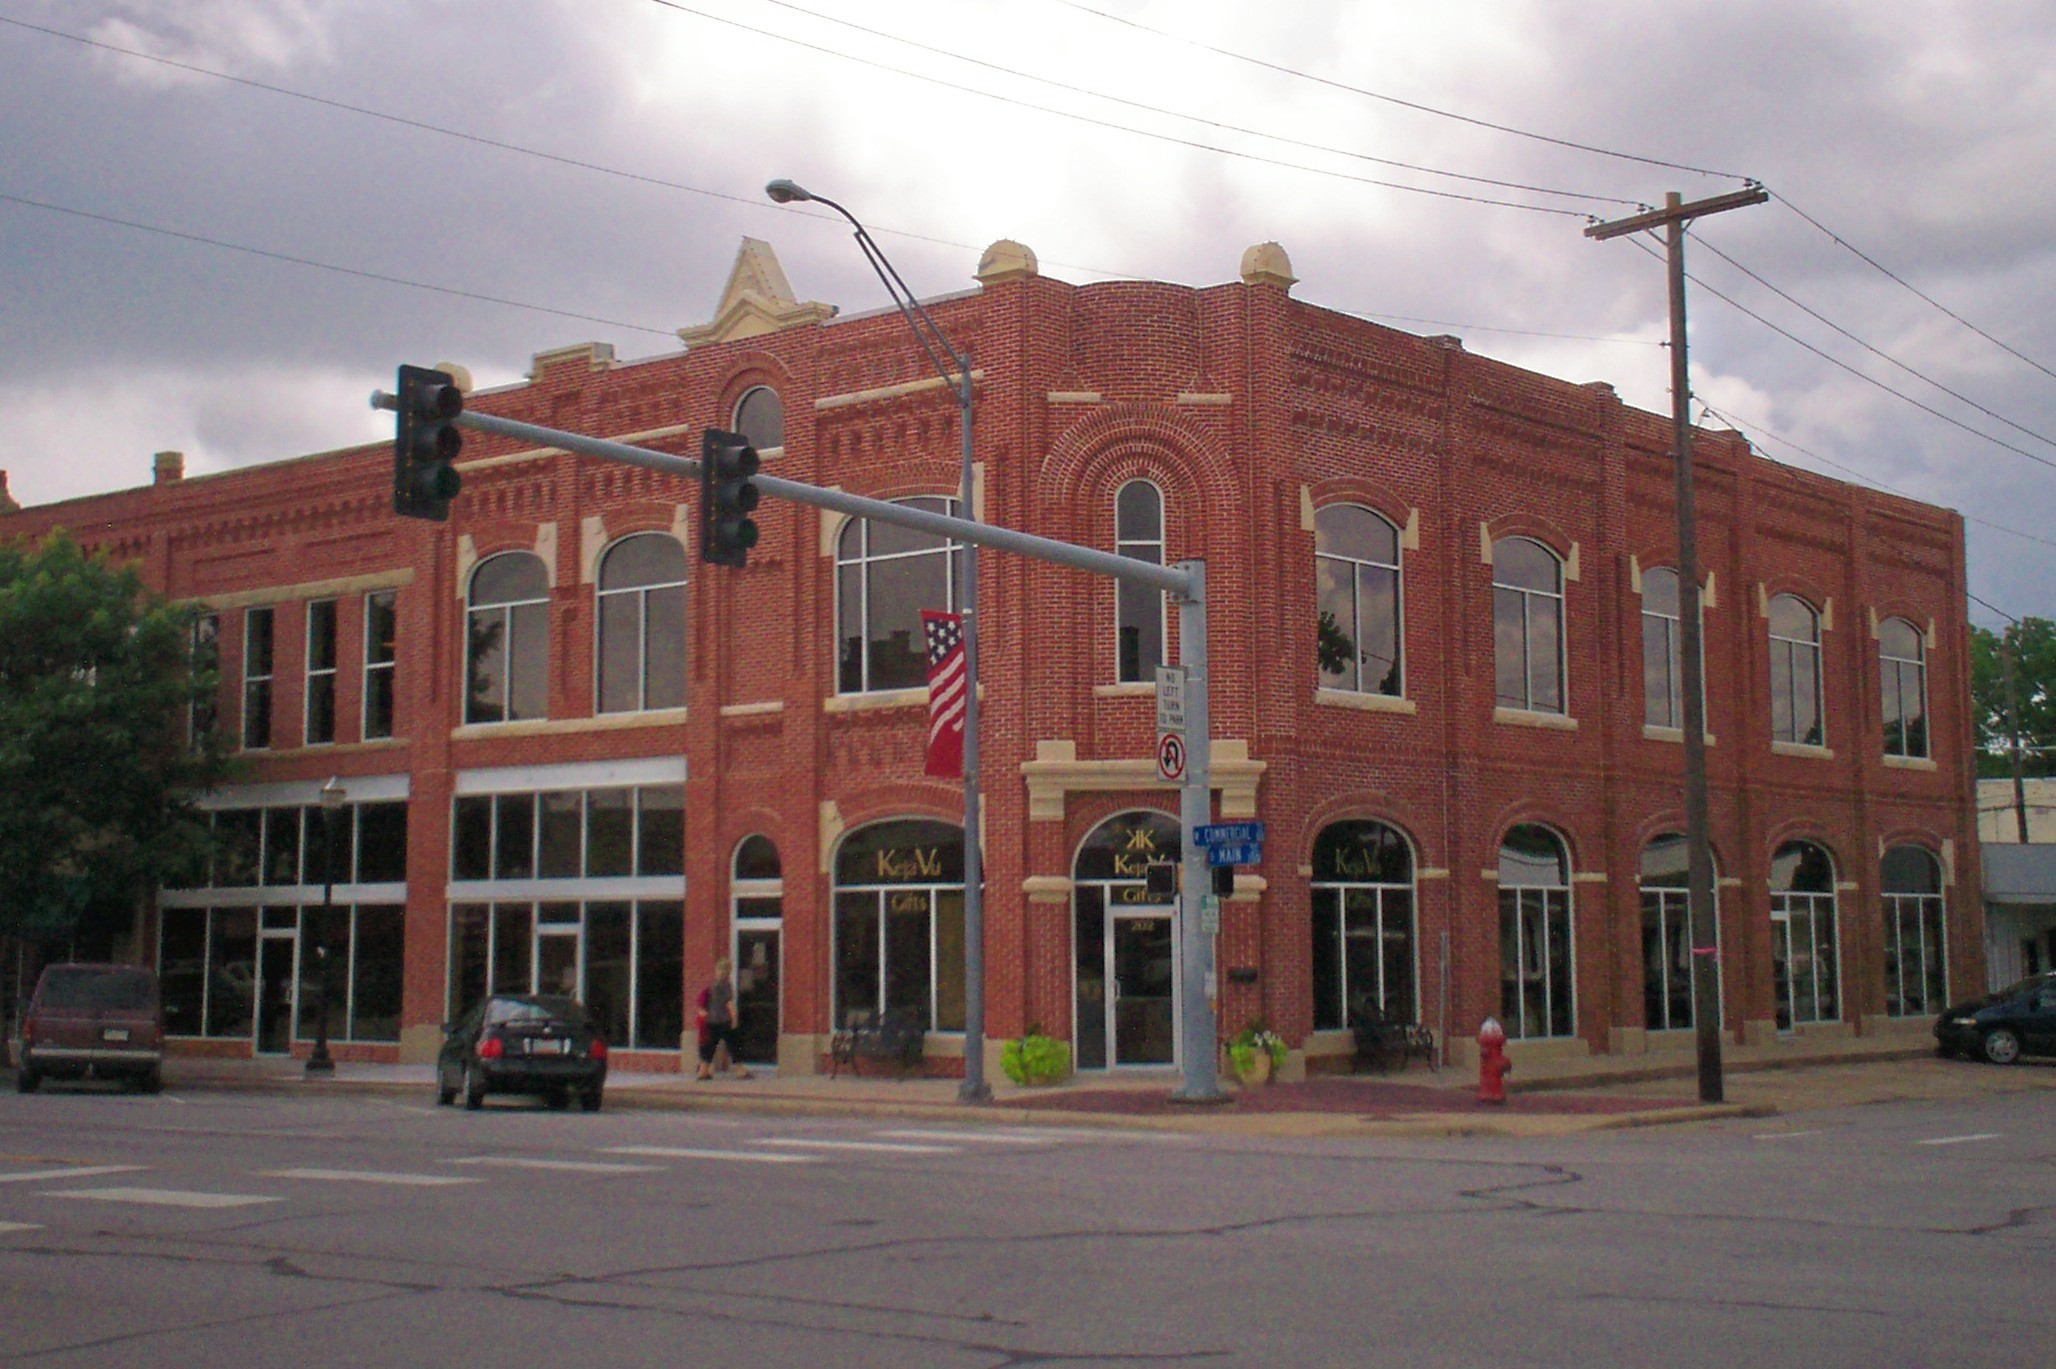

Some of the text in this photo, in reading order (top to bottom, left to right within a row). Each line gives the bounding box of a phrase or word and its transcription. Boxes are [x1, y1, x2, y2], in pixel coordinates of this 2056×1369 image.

[1166, 672, 1176, 684] NO
[1162, 685, 1179, 697] LEFT
[1163, 698, 1180, 711] TURN
[1204, 825, 1251, 843] COMMERCIAL
[1219, 847, 1242, 863] MAIN
